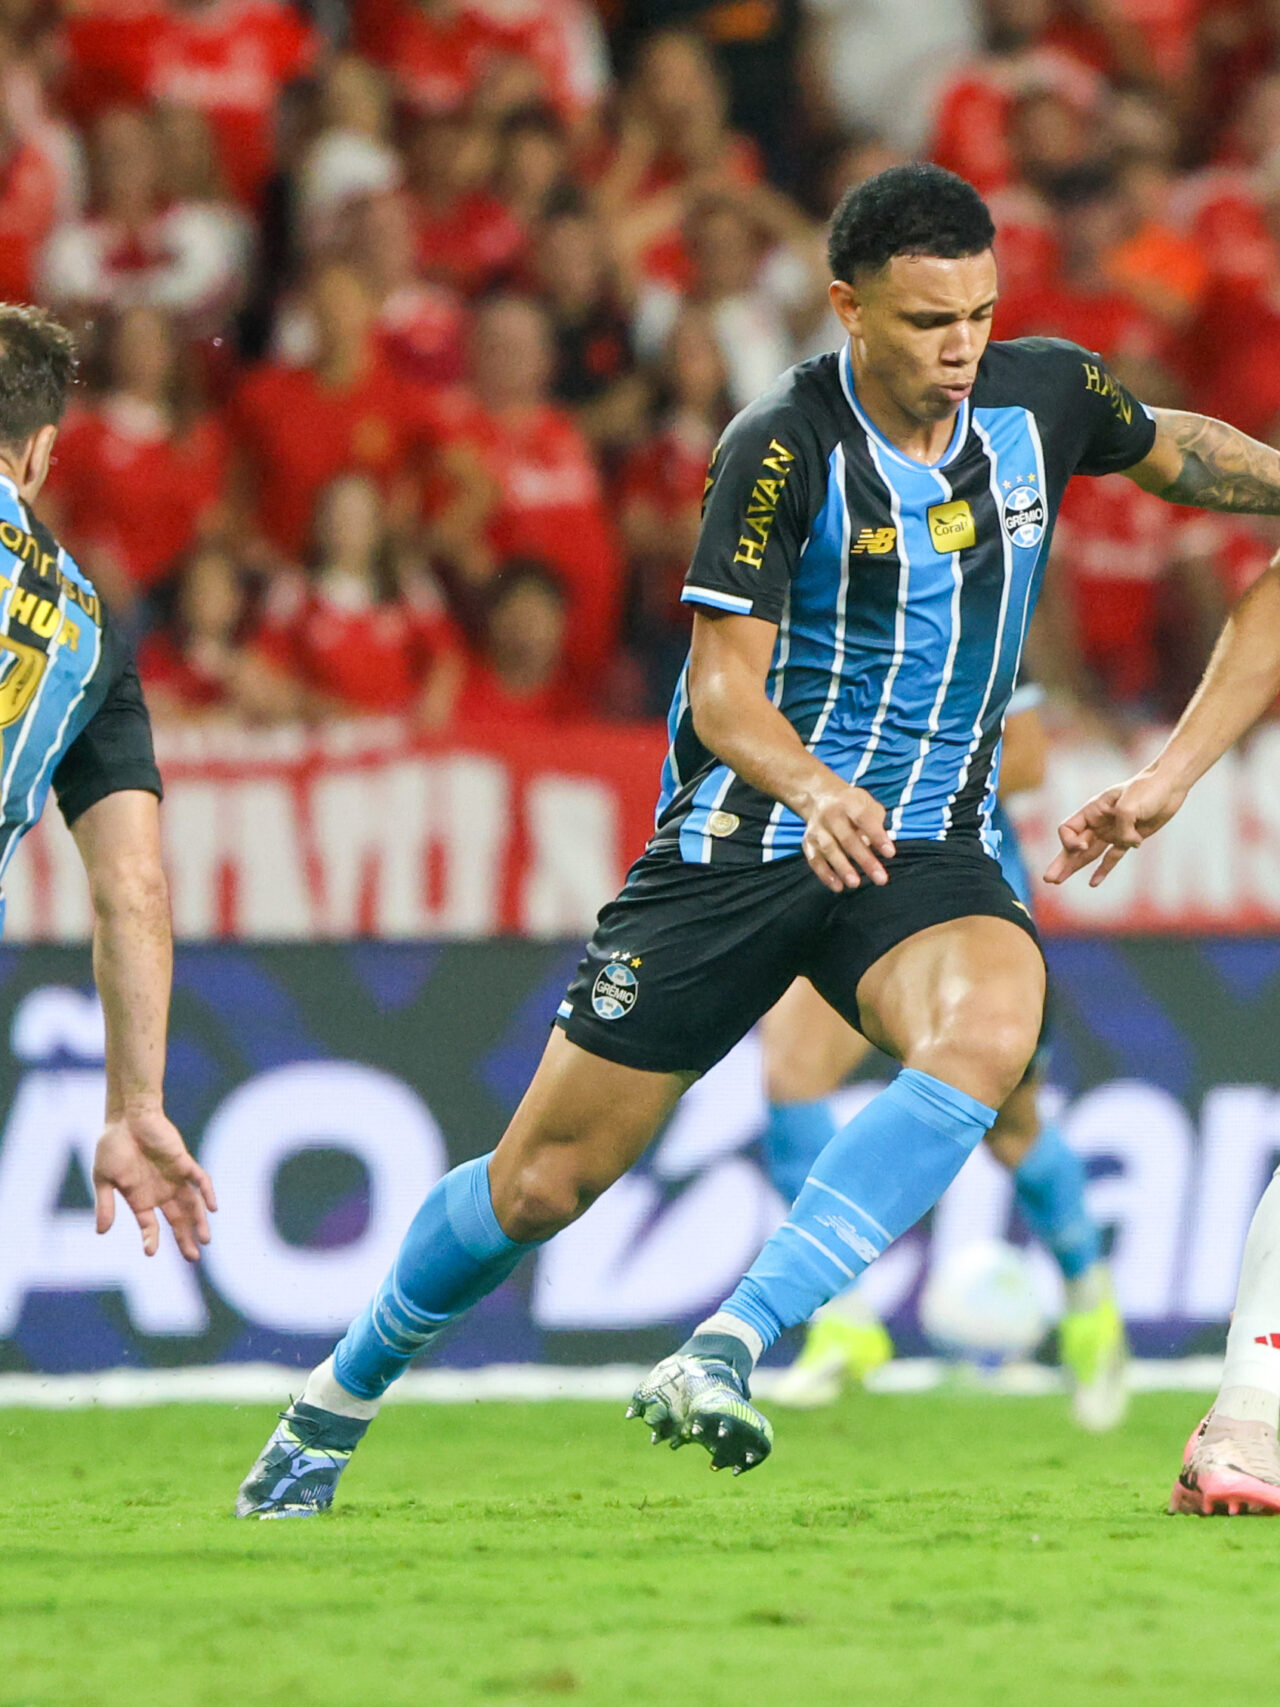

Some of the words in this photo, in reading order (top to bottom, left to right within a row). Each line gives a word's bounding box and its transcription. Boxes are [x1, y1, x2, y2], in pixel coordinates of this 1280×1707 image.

[733, 438, 796, 571] HAVAN
[934, 520, 966, 537] Coral
[1004, 508, 1044, 530] GRÊMIO
